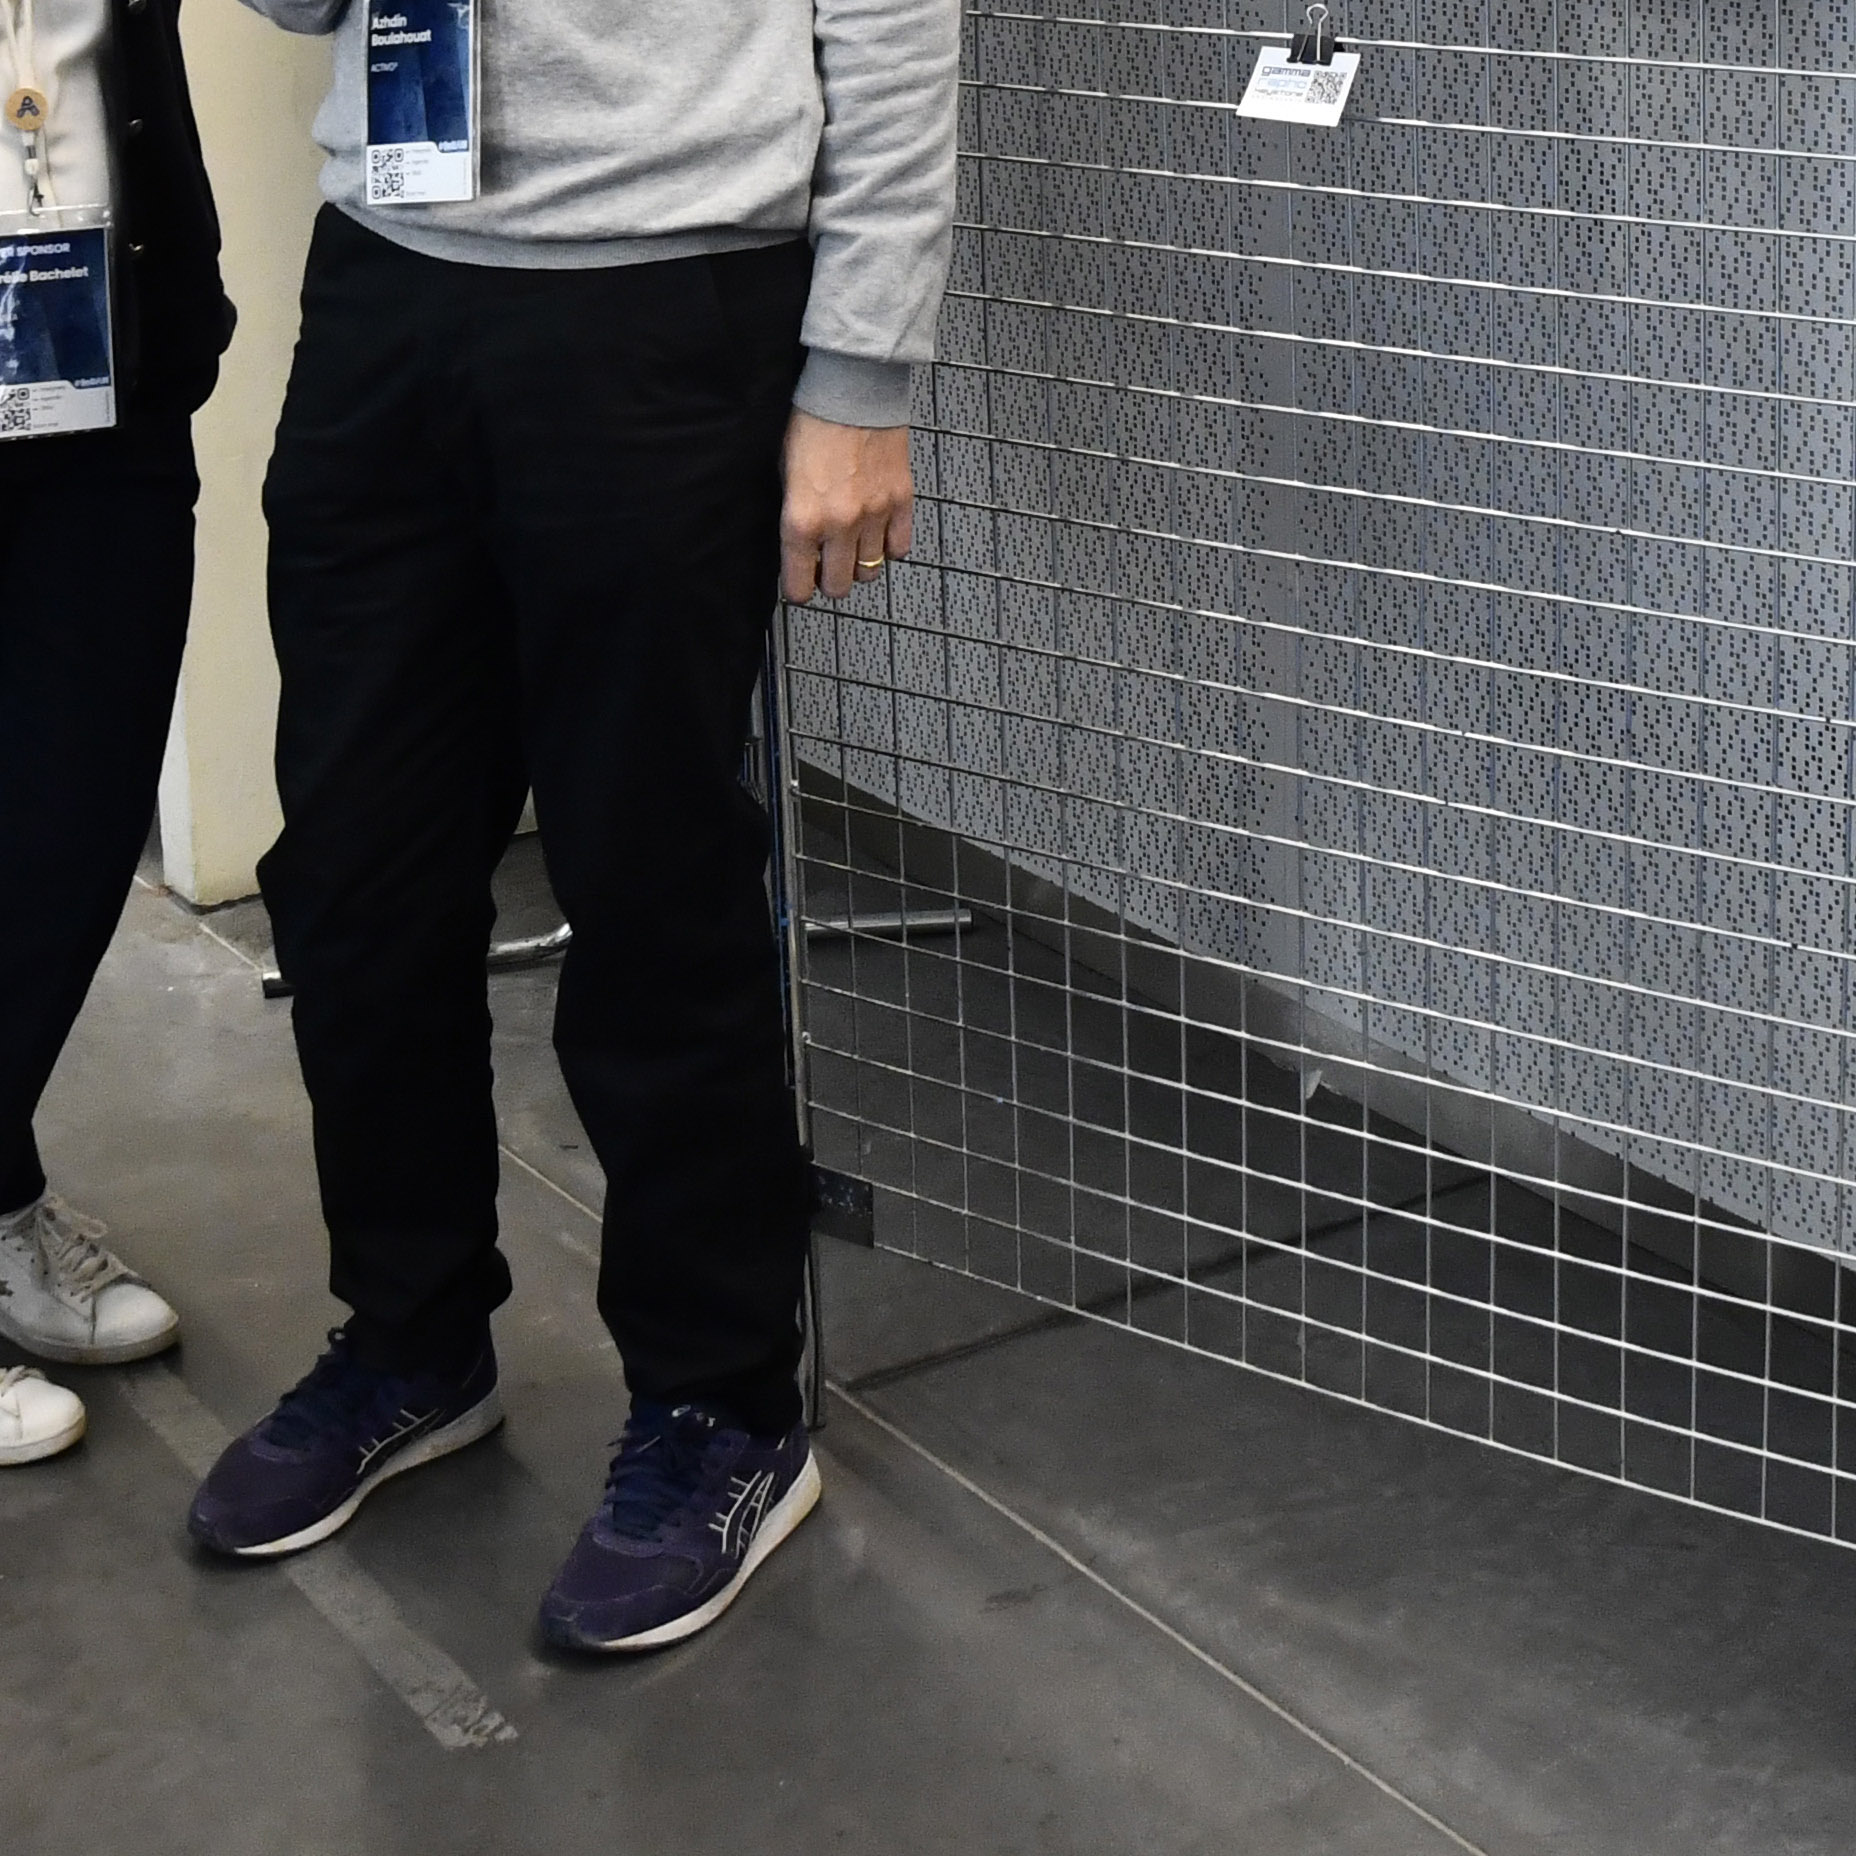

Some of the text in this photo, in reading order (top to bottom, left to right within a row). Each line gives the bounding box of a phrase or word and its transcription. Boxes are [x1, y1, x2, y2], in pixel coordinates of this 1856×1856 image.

[371, 13, 407, 30] Azhdin
[1261, 66, 1312, 77] gamma
[16, 243, 70, 257] SPONSOR
[29, 266, 89, 282] Bachelet
